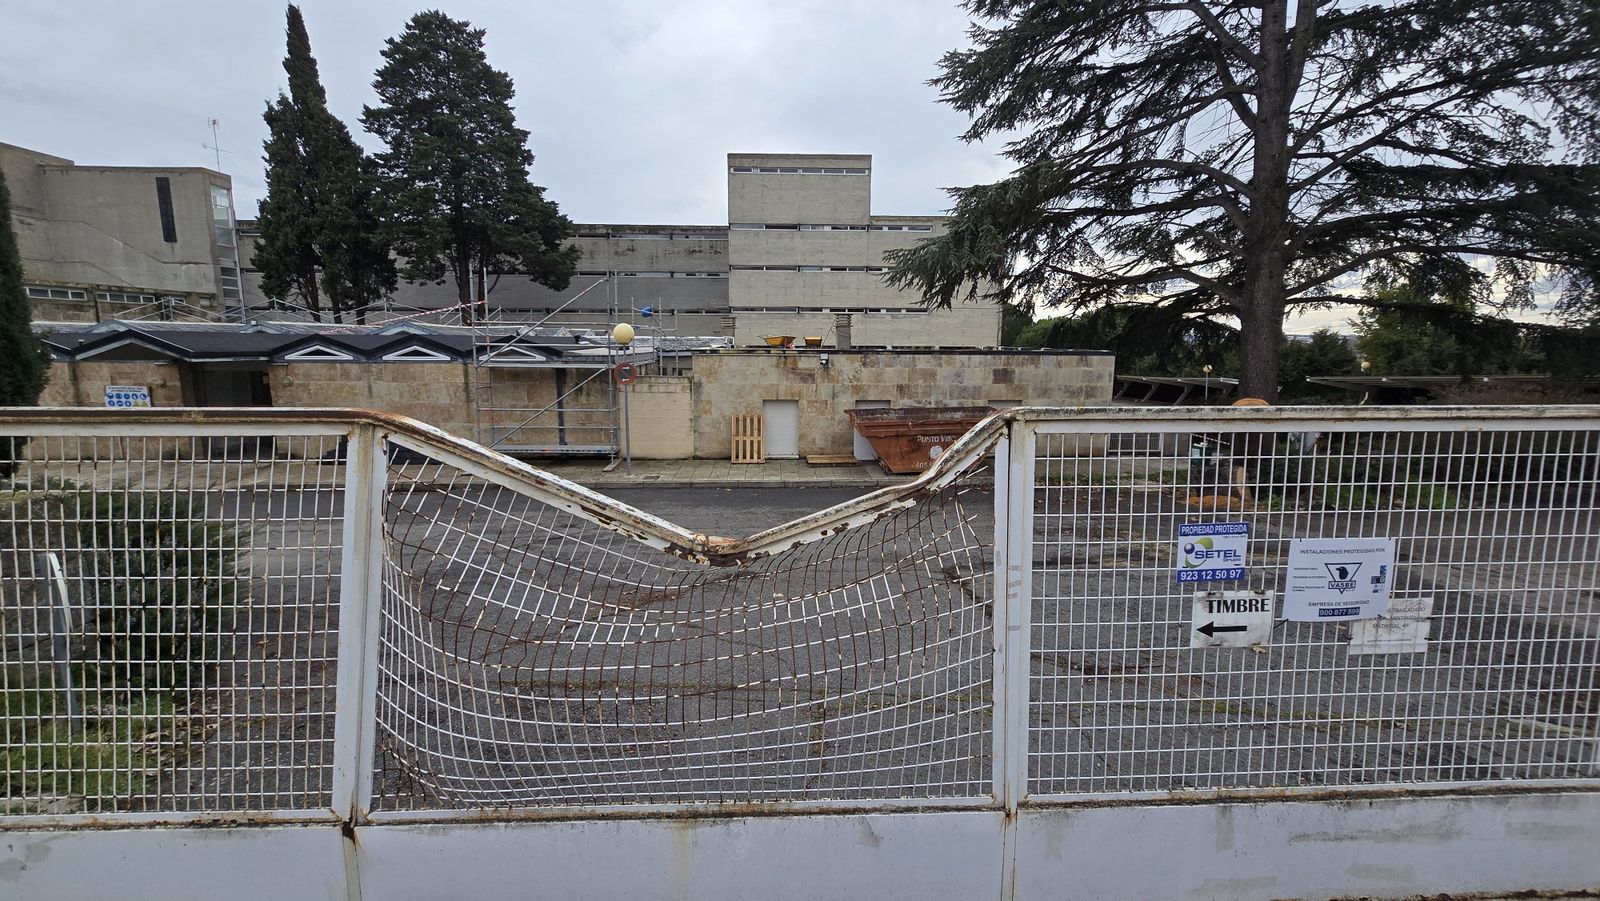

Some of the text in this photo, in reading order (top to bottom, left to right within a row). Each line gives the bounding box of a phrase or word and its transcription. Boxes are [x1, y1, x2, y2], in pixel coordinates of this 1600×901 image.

[1181, 524, 1247, 535] PROPIEDAD PROTEGIDA
[1194, 549, 1241, 559] SETEL
[1180, 569, 1241, 580] 923 12 50 97
[1206, 598, 1270, 614] TIMBRE
